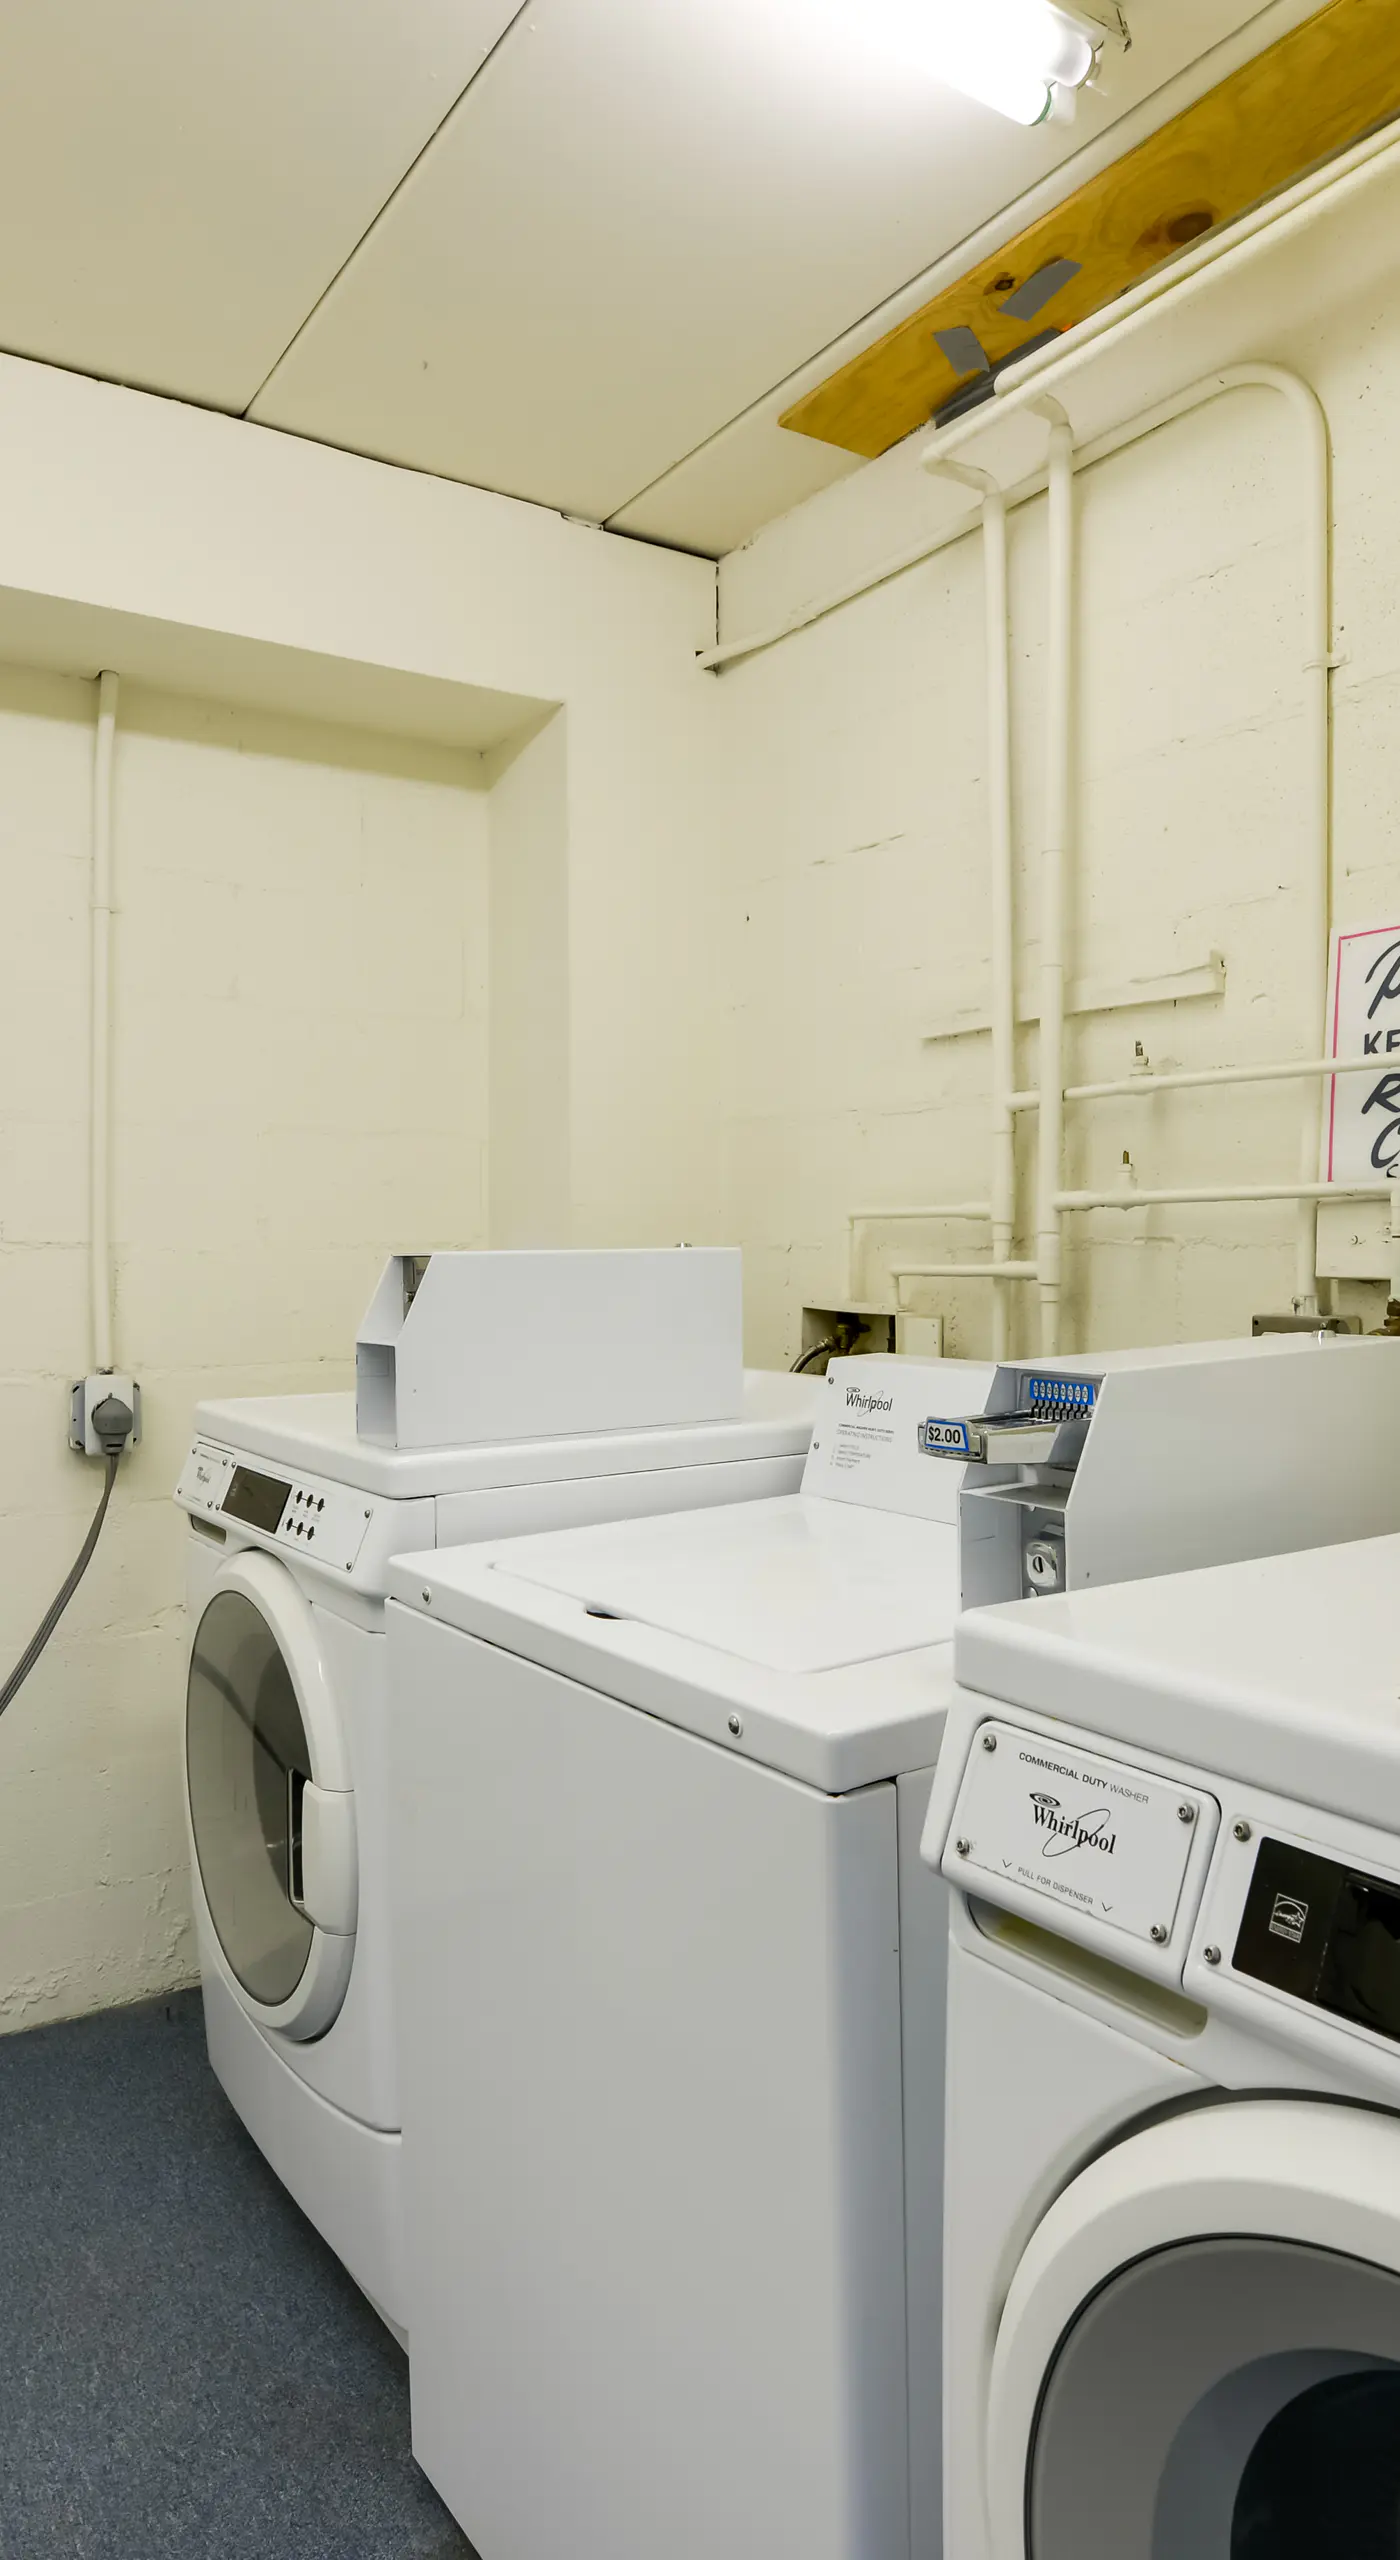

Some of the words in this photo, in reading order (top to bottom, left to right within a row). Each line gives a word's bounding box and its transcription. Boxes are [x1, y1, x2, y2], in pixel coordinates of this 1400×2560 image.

[846, 1392, 894, 1413] Whirlpool
[928, 1426, 961, 1444] $2.00
[1018, 1752, 1080, 1780] COMMERCIAL
[1081, 1773, 1109, 1790] DUTY
[1109, 1783, 1150, 1804] WASHER
[1033, 1803, 1117, 1855] Whirlpool
[1017, 1866, 1035, 1881] PULL
[1036, 1874, 1052, 1888] FOR
[1052, 1881, 1094, 1905] DISPENSER
